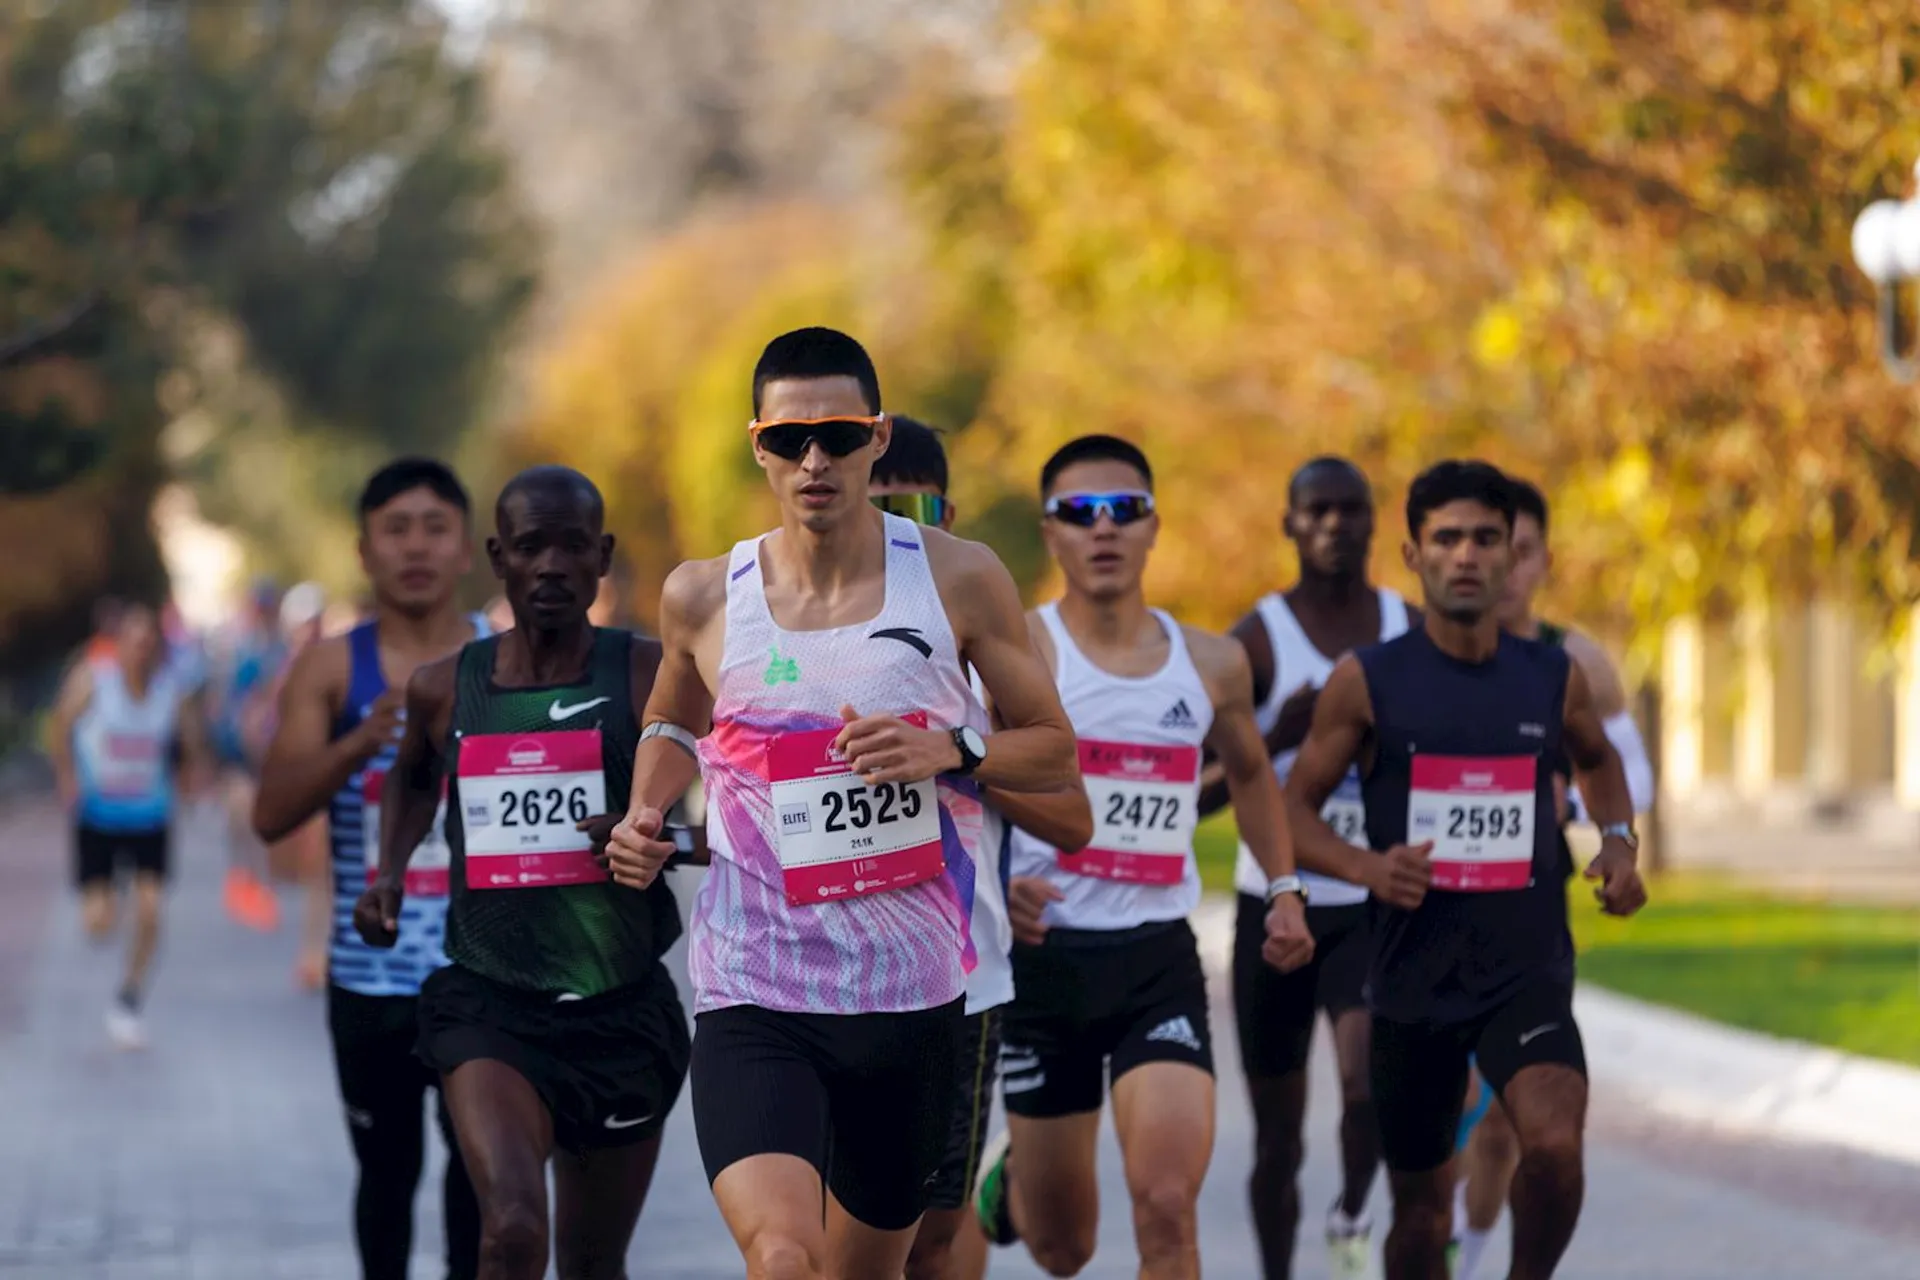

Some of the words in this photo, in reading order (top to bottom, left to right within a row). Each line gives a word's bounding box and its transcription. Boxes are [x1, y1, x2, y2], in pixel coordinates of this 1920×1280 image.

[500, 787, 588, 828] 2626
[783, 812, 808, 825] ELITE
[821, 782, 921, 833] 2525
[1105, 791, 1180, 831] 2472
[1447, 806, 1521, 839] 2593
